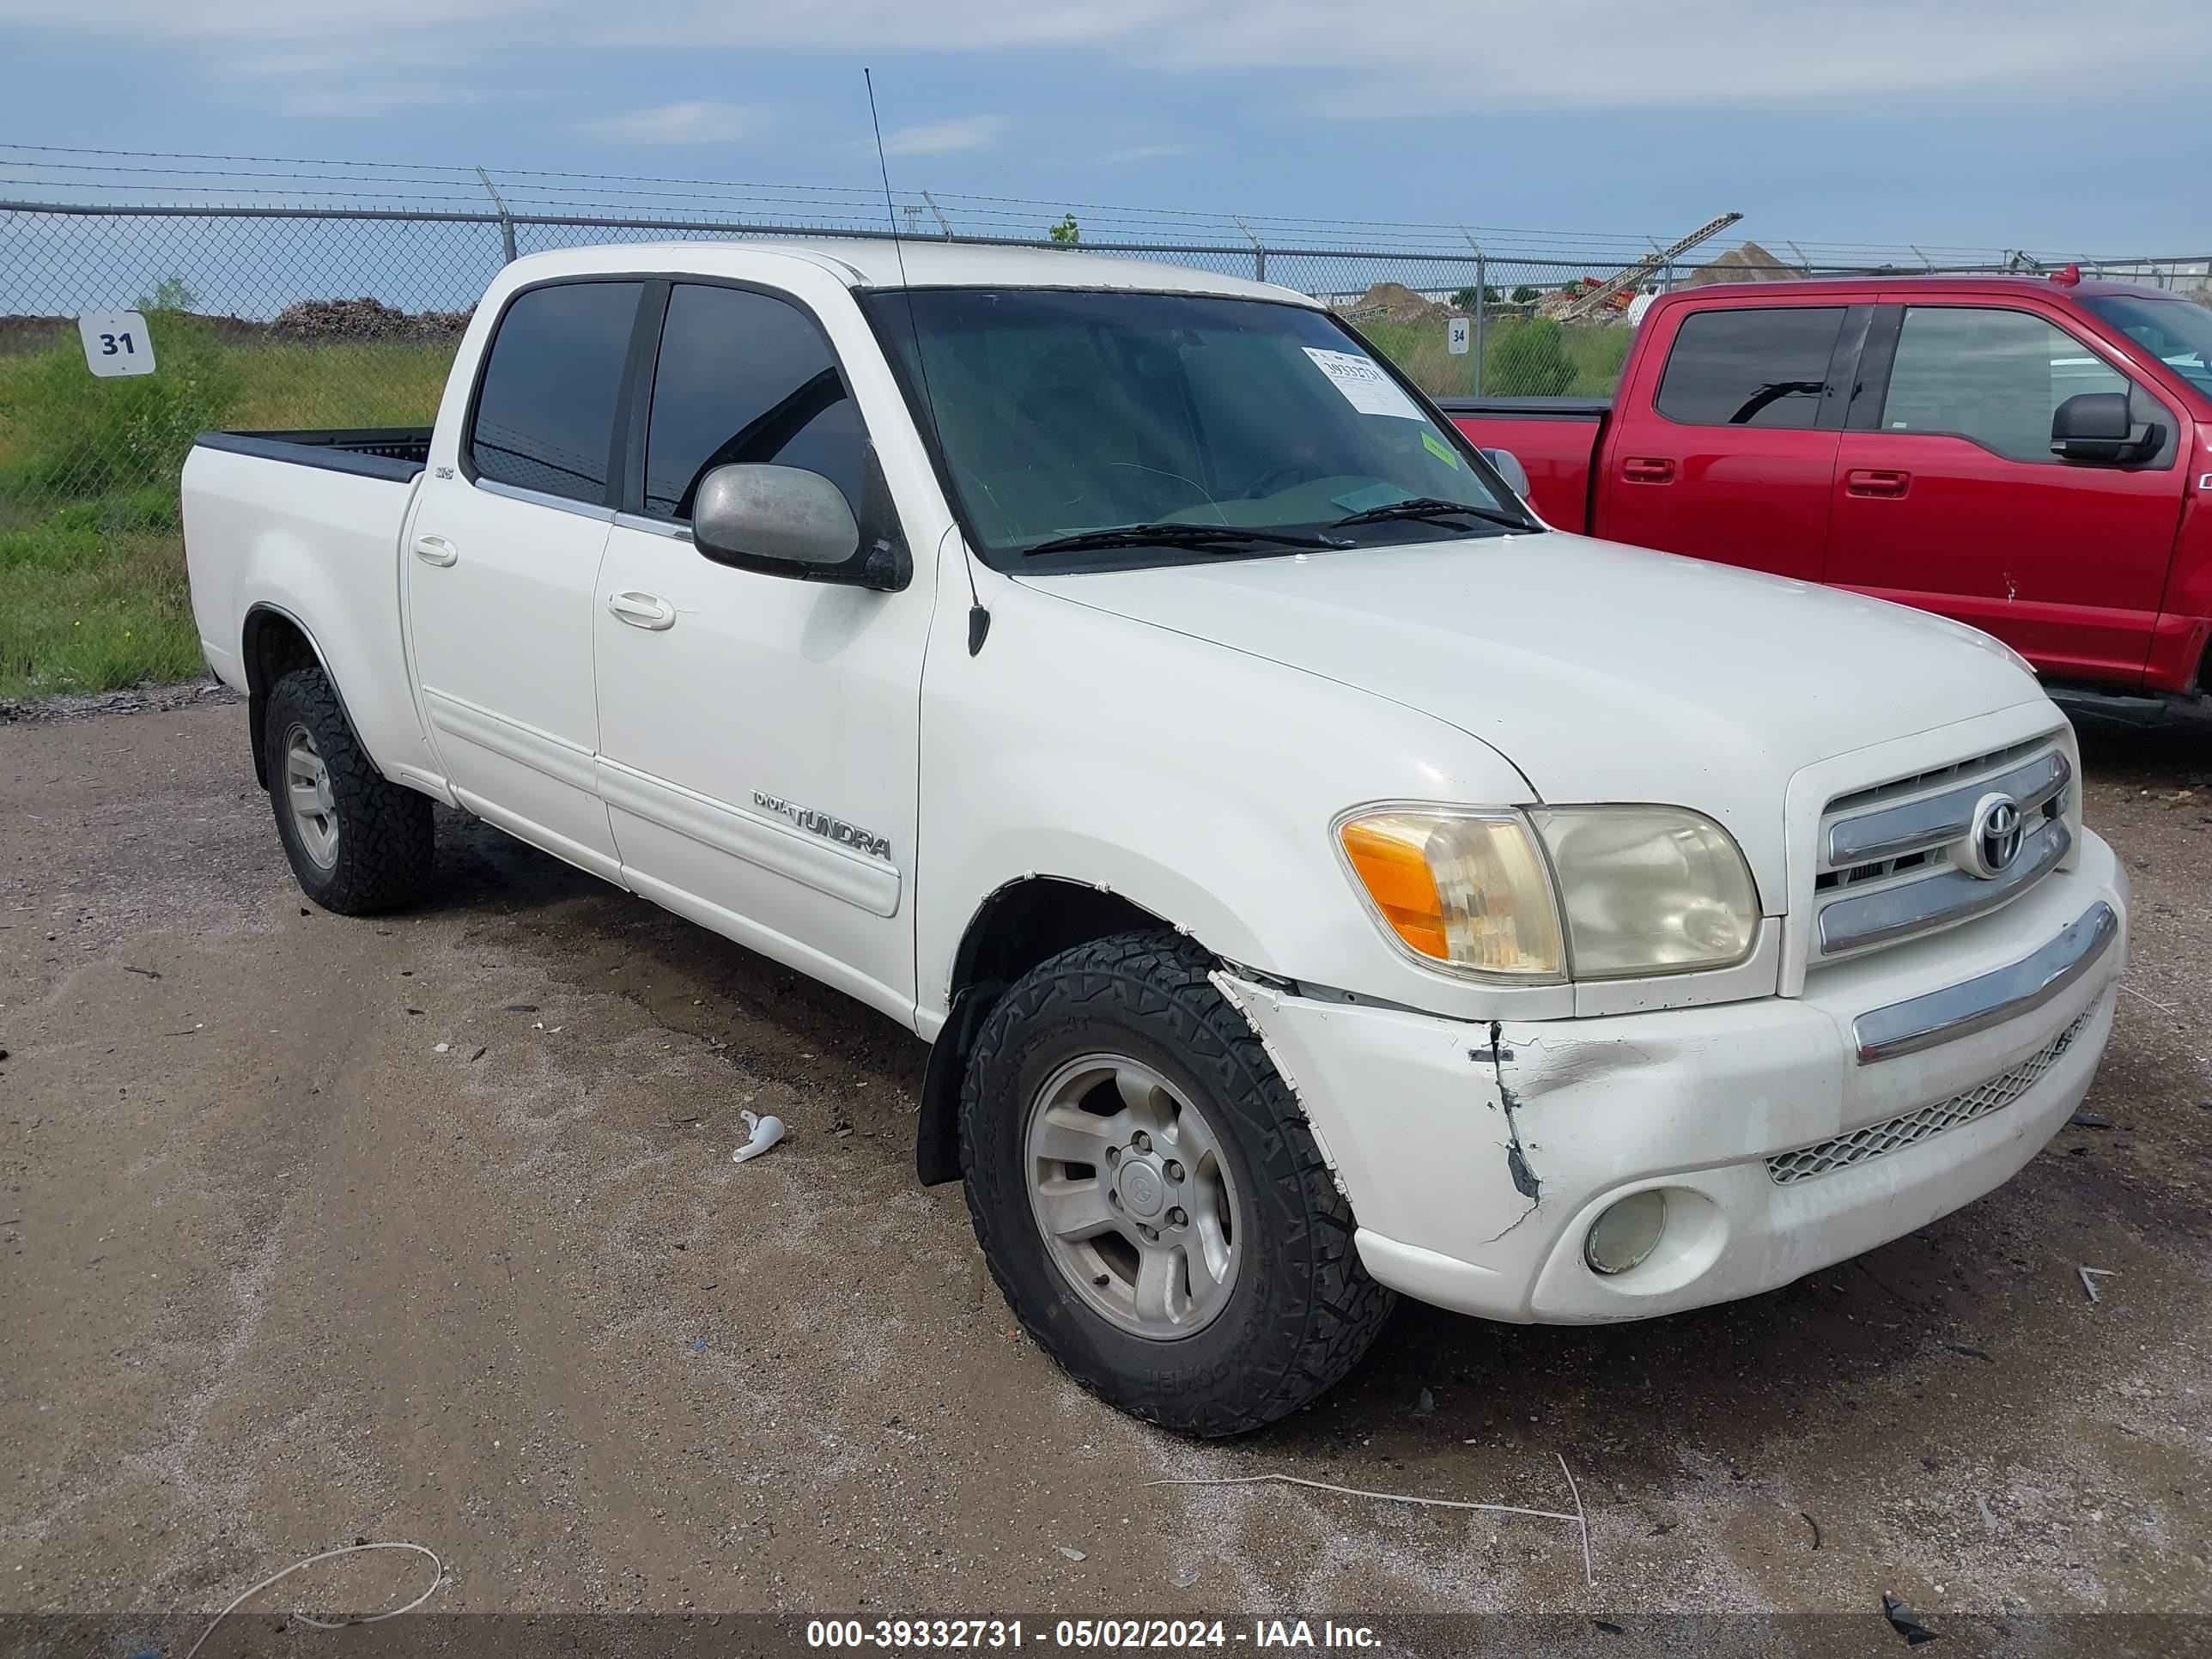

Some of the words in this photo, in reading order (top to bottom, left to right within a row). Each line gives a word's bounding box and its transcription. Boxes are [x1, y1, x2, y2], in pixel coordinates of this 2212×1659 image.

[100, 332, 135, 356] 31
[1453, 329, 1465, 343] 34
[1323, 362, 1385, 381] 39332731
[750, 789, 791, 816] TOYOTA
[790, 804, 891, 860] TUNDRA
